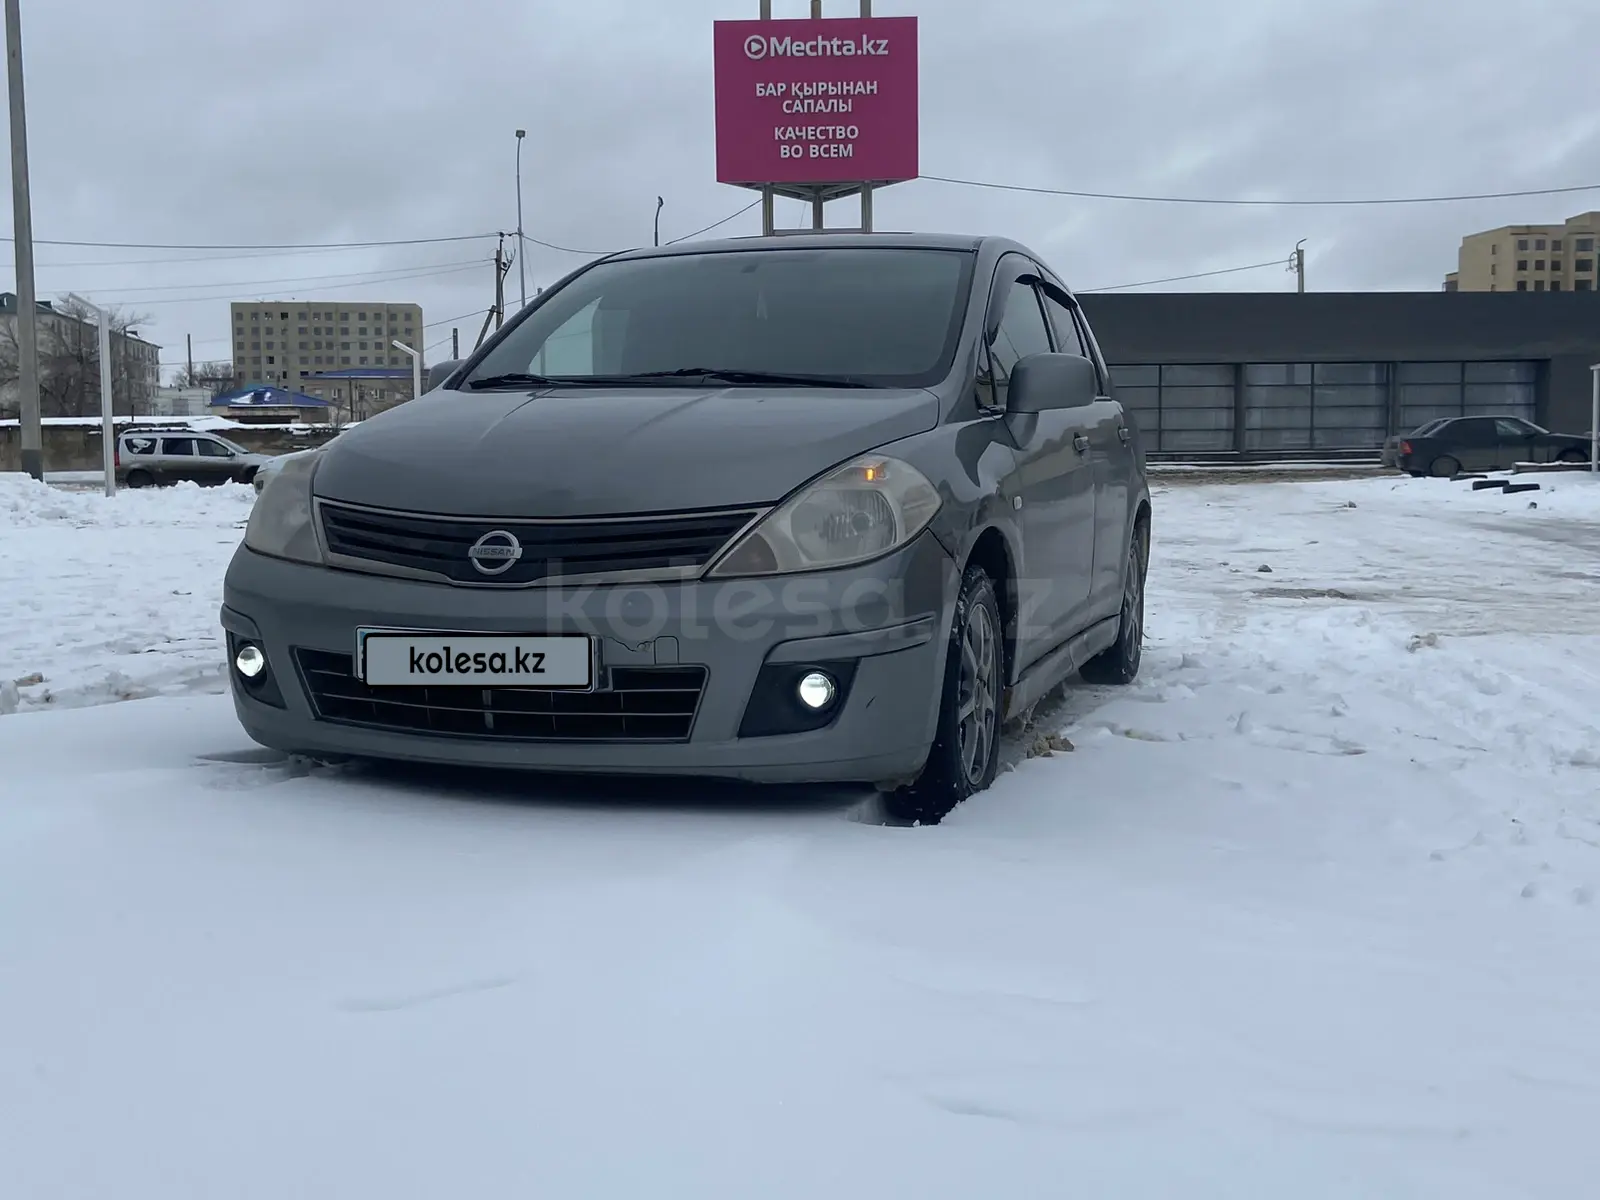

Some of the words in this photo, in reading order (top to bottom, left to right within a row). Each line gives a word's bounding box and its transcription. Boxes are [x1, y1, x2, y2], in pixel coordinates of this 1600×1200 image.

[770, 34, 889, 57] Mechta.kz
[756, 83, 787, 97] БАР
[791, 81, 878, 98] ҚЫРЫНАН
[782, 99, 852, 113] САПАЛЫ
[774, 125, 859, 140] КАЧЕСТВО
[780, 145, 803, 158] ВО
[809, 144, 853, 158] ВСЕМ
[472, 547, 516, 557] NISSAN
